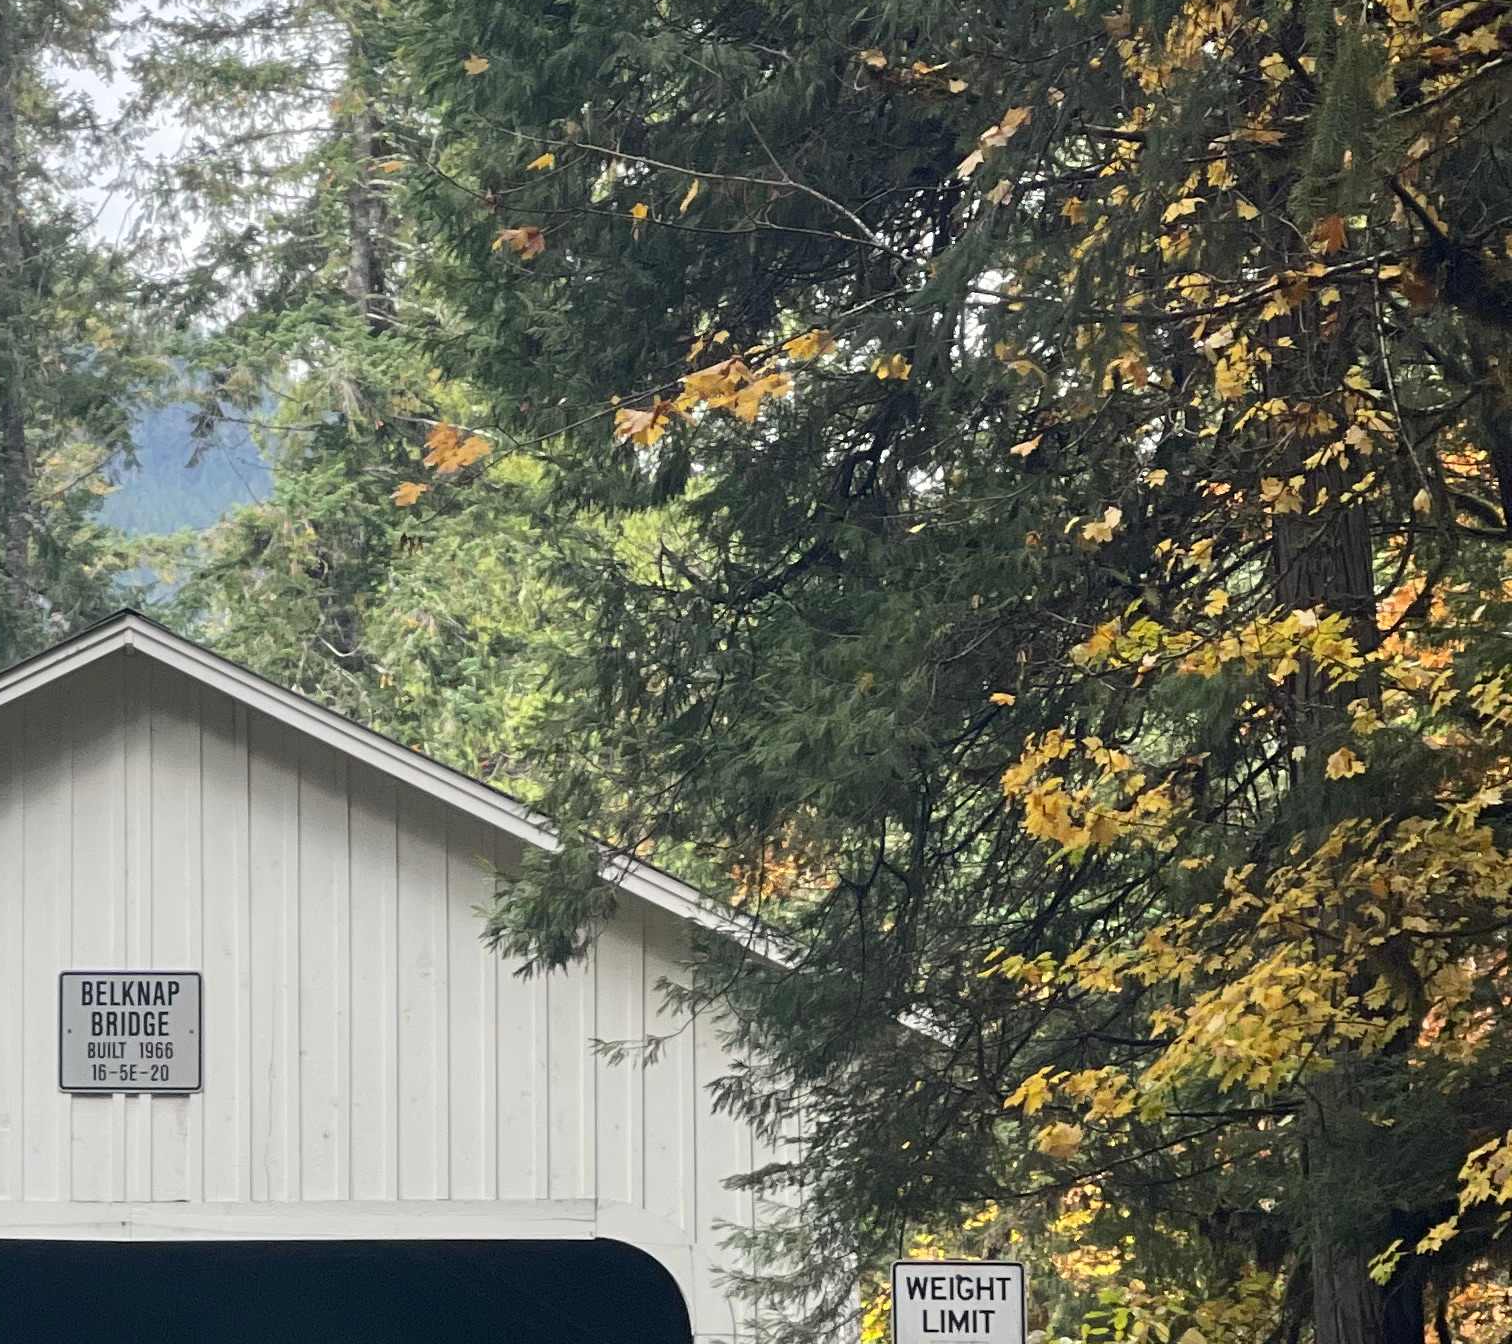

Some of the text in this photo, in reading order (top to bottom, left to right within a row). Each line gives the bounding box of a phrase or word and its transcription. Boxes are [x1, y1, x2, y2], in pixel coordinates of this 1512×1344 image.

[81, 981, 180, 1006] BELKNAP
[91, 1011, 170, 1036] BRIDGE
[88, 1042, 174, 1059] BUILT 1966
[92, 1064, 169, 1081] 16-5E-20
[906, 1276, 1011, 1301] WEIGHT
[923, 1309, 995, 1333] LIMIT
